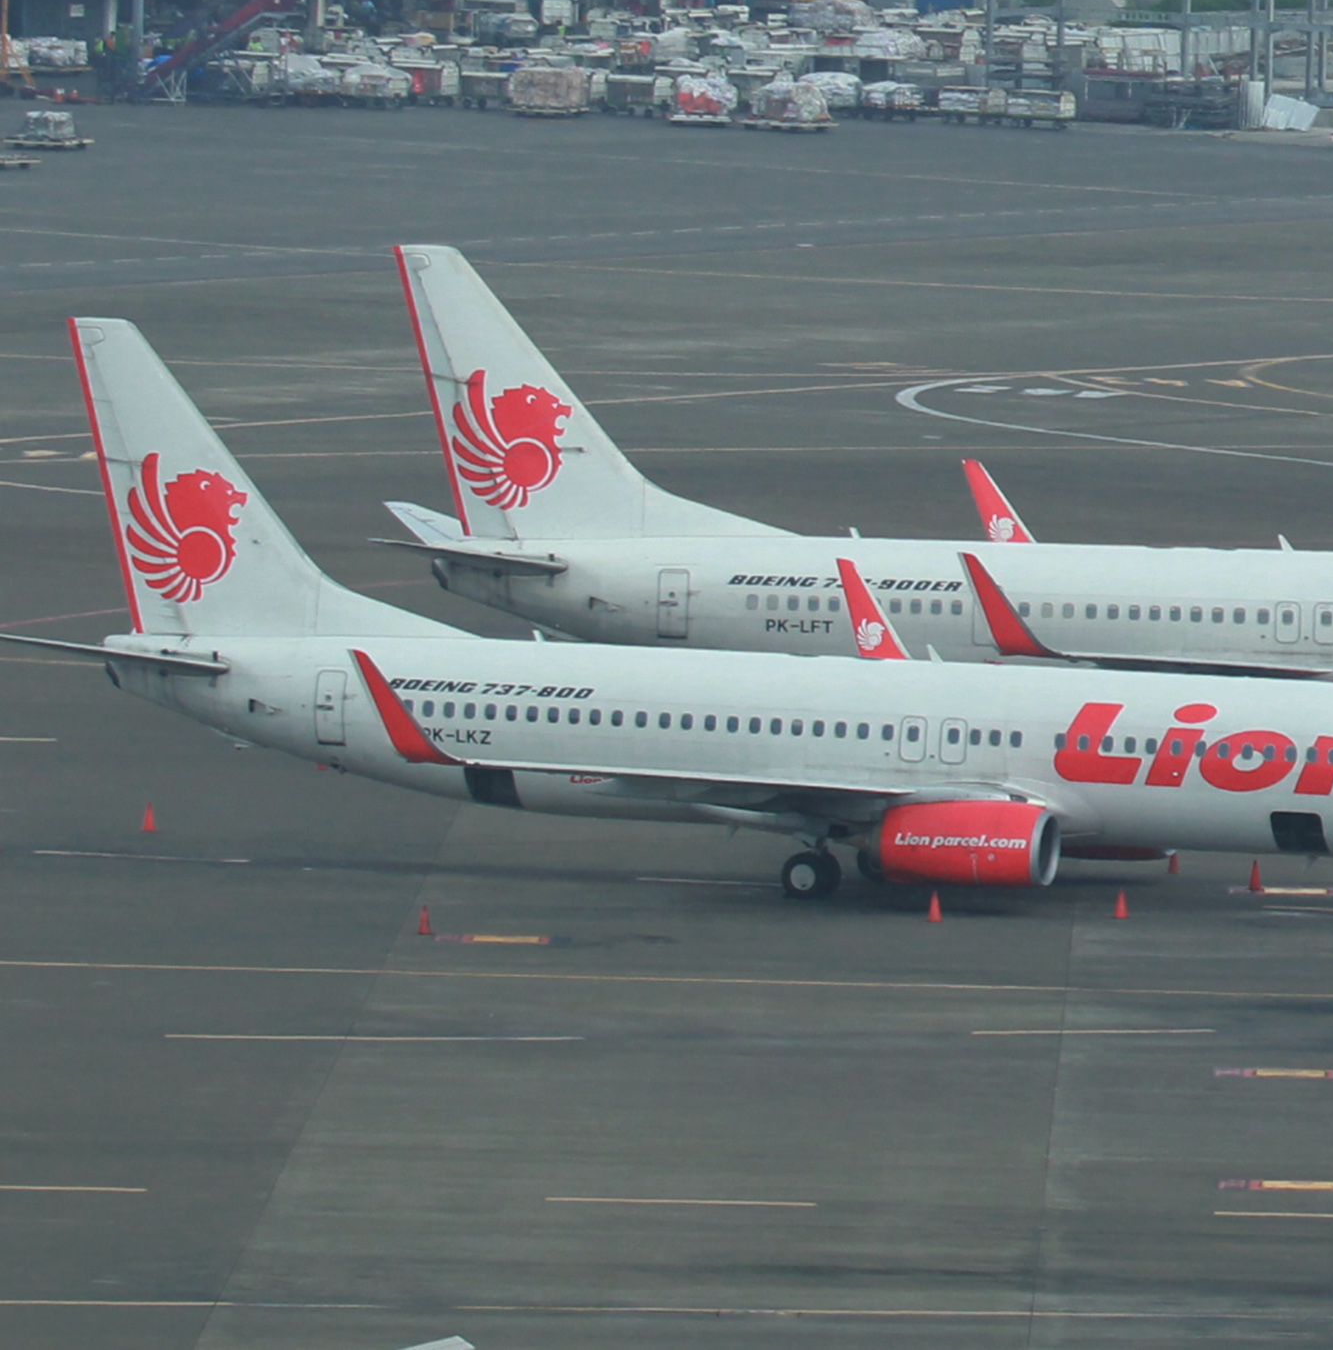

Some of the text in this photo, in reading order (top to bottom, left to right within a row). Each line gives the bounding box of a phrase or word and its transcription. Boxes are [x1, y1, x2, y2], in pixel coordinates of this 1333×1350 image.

[727, 574, 819, 588] BOEING
[766, 619, 834, 634] PK-LFT
[390, 677, 595, 700] BOEING 737-800
[894, 832, 1028, 849] Lion parcel.com
